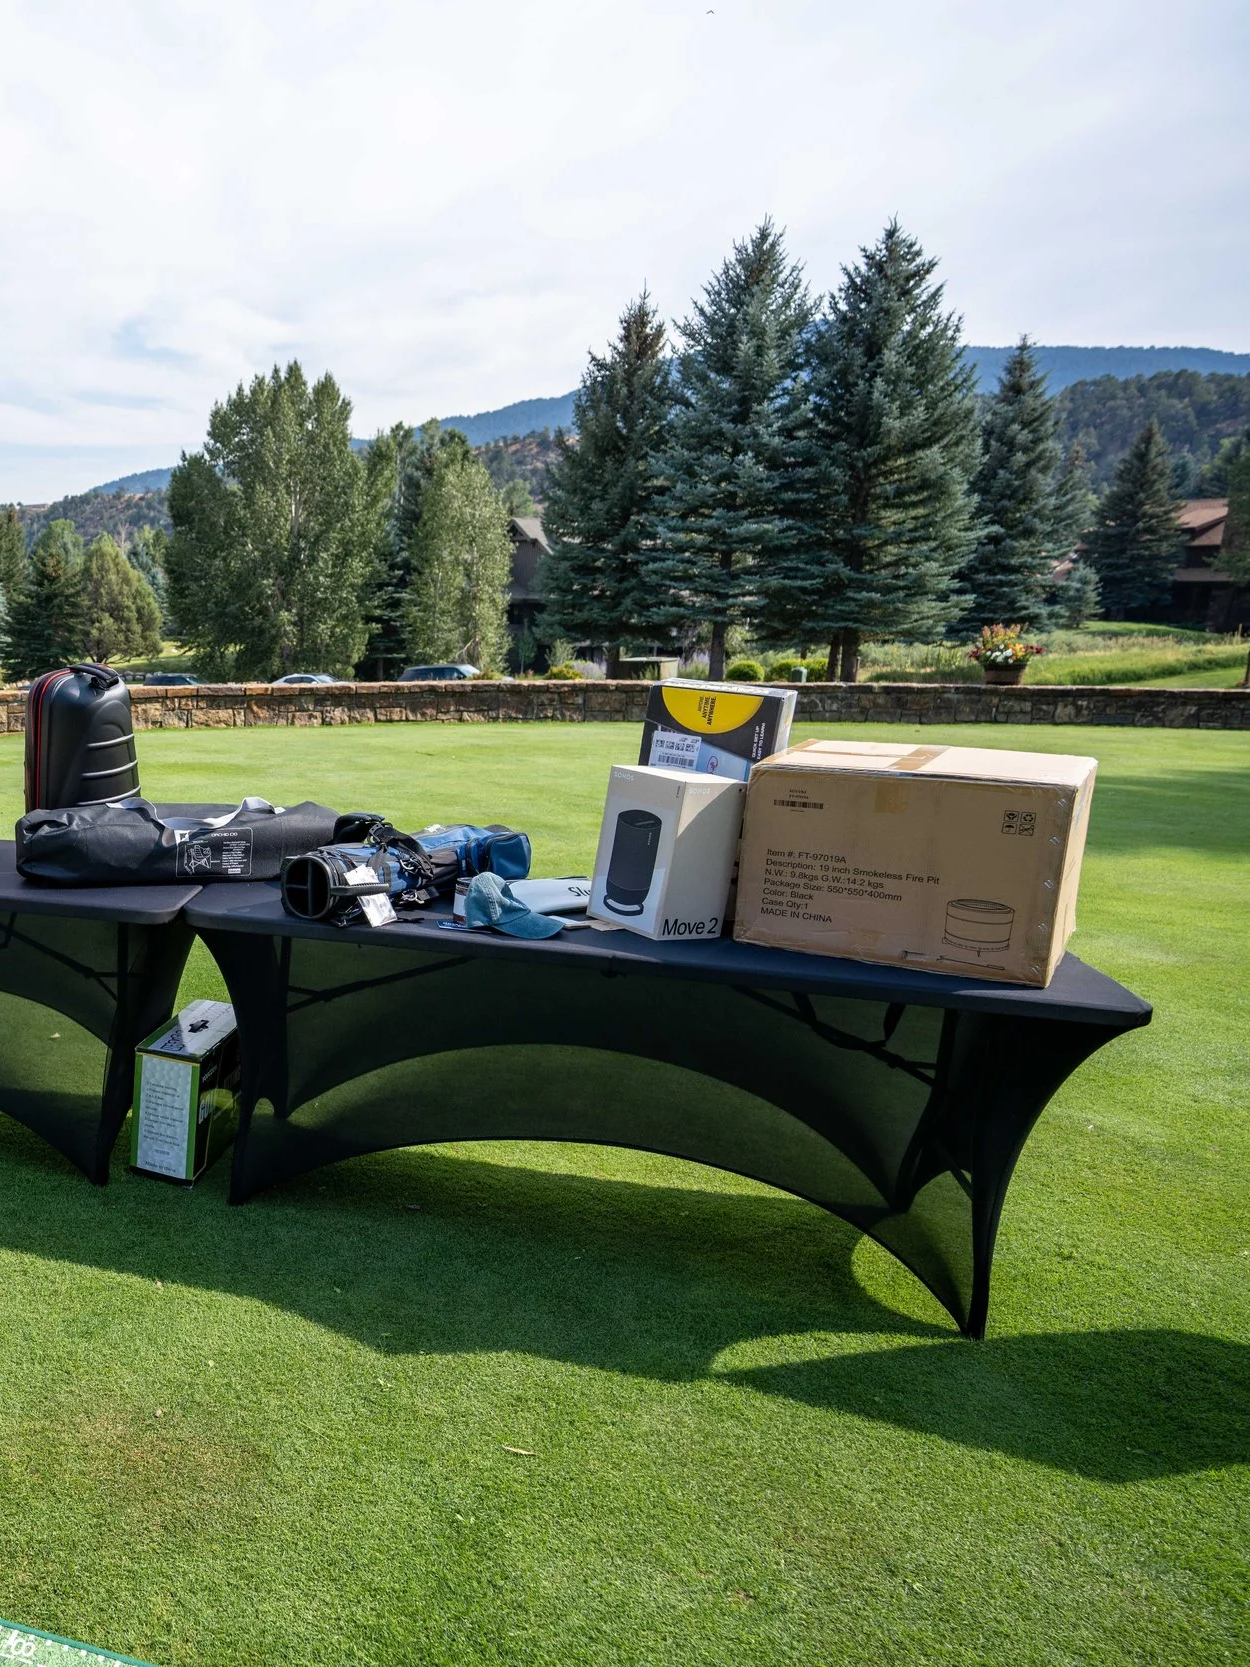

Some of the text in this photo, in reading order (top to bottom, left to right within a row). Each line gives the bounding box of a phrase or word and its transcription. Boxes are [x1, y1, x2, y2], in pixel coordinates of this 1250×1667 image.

[766, 848, 785, 857] Item
[798, 851, 846, 864] FT-97019A
[764, 868, 788, 878] N.W.:
[790, 872, 818, 882] 9.8kgs
[868, 880, 884, 890] kgs
[766, 858, 940, 884] Description: 19 inch Smokeless Fire Pit
[764, 878, 800, 890] Package
[803, 882, 825, 892] Size:
[763, 888, 814, 900] Color: Black
[762, 898, 808, 910] Case Qty:1
[760, 907, 832, 923] MADE IN CHINA
[662, 917, 718, 936] Move 2
